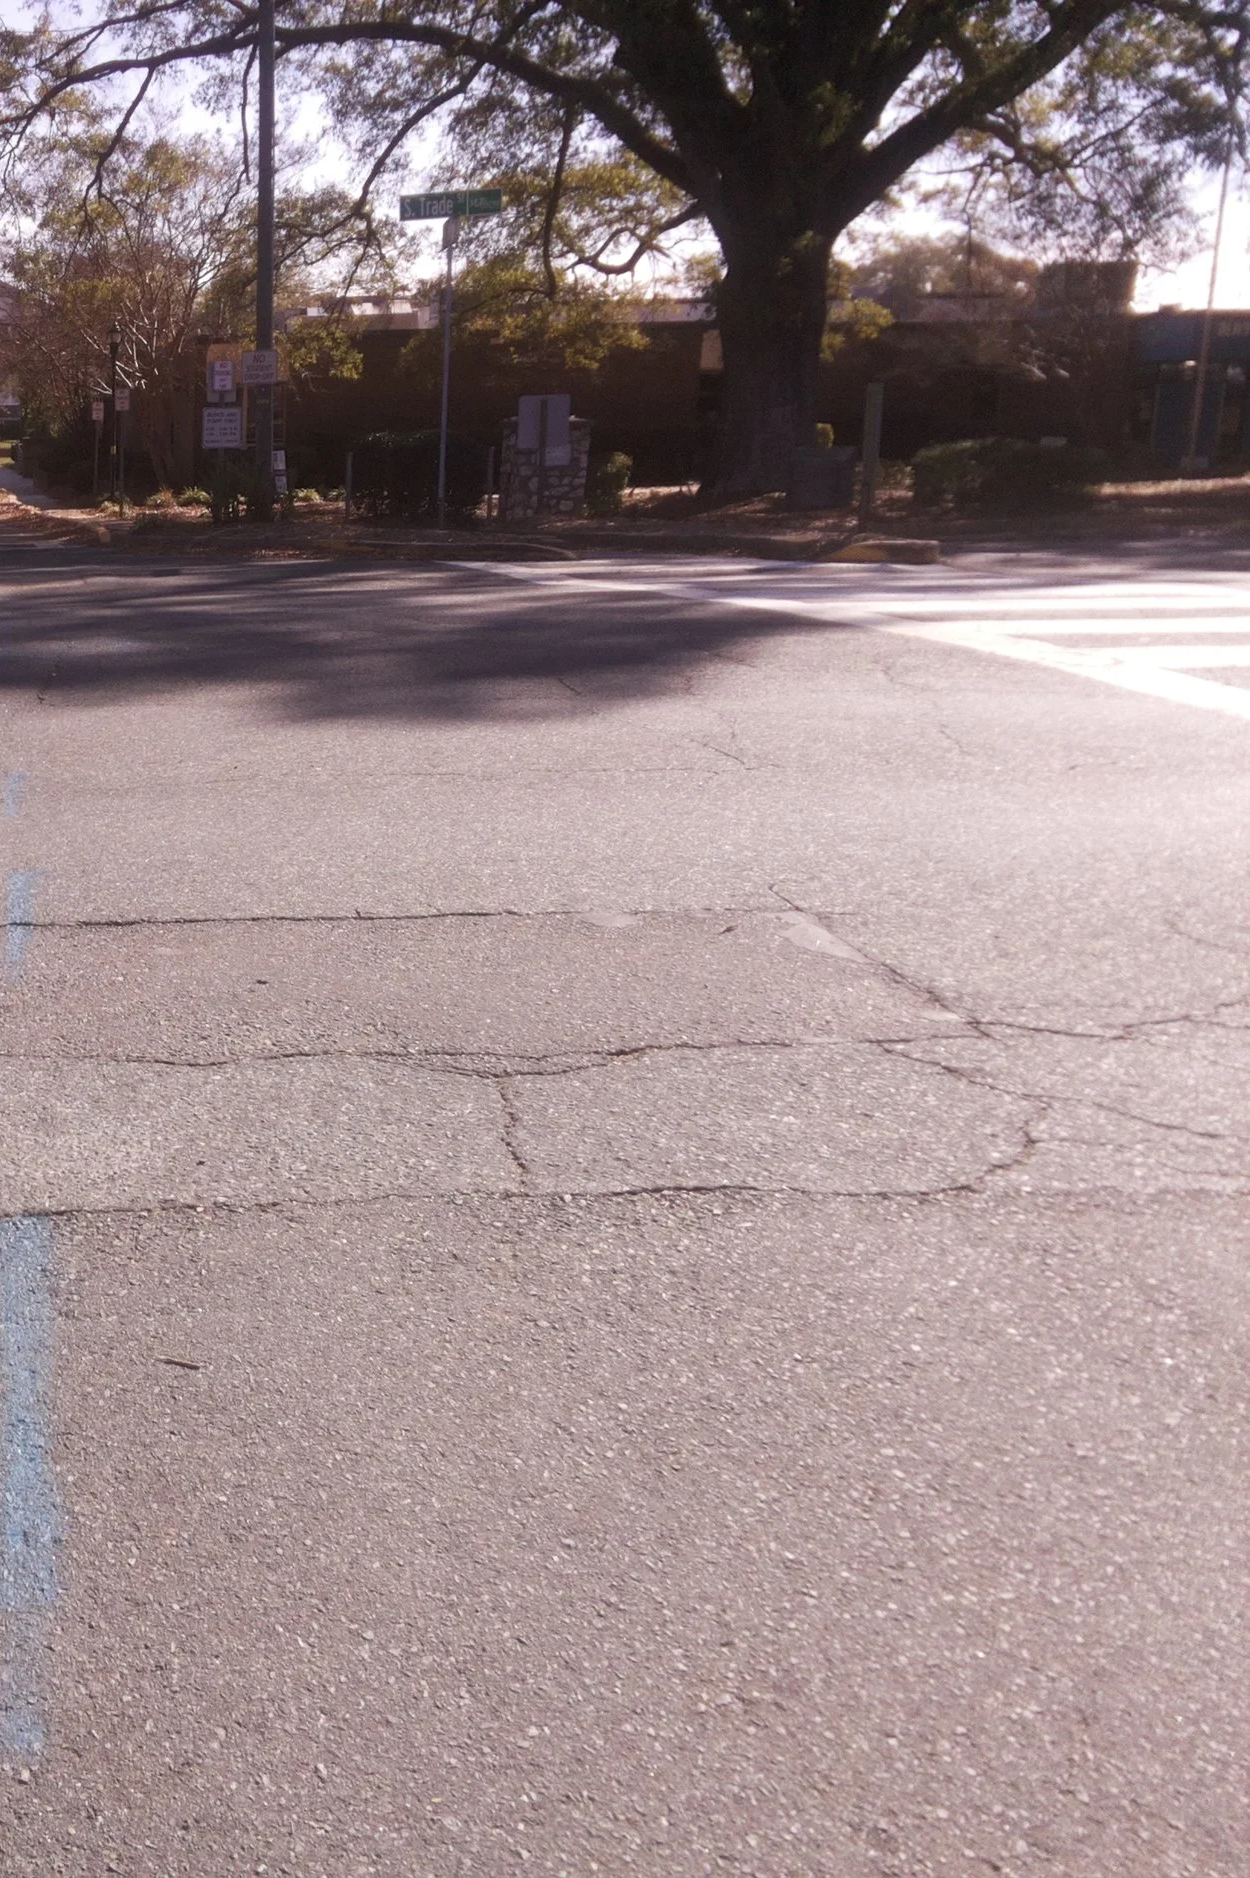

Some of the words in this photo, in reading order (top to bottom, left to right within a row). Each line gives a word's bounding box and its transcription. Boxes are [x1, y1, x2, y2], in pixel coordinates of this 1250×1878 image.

[404, 198, 415, 217] S.
[419, 195, 454, 216] Trade
[253, 354, 266, 363] NO
